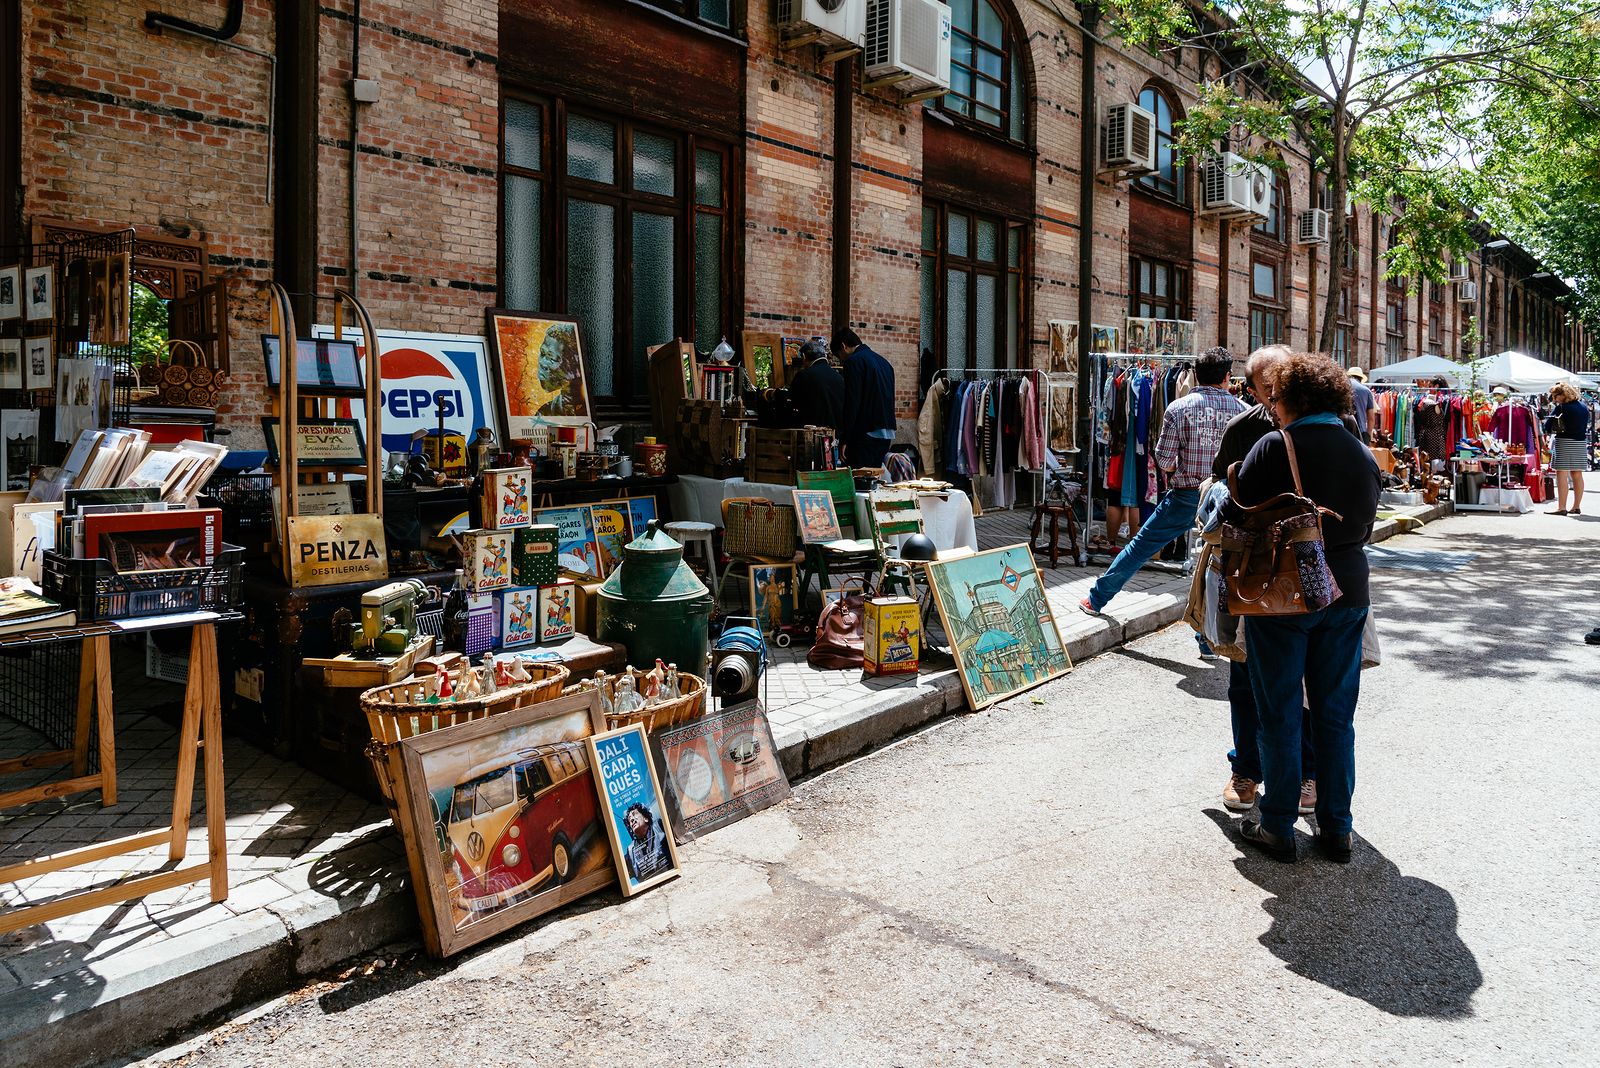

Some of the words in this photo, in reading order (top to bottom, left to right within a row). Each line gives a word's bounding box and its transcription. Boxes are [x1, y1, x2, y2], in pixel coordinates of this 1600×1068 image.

[297, 426, 309, 434] OR
[304, 435, 344, 444] EVA
[500, 516, 515, 525] Cola
[597, 525, 616, 534] AROS
[300, 539, 379, 563] PENZA
[311, 564, 370, 576] DESTILERIAS
[479, 578, 494, 588] Cola
[495, 576, 509, 584] Cao
[505, 634, 519, 643] Cola
[520, 631, 533, 640] Cao
[544, 628, 559, 637] Cola
[560, 625, 573, 634] Cao
[597, 735, 629, 764] DALÍ
[602, 753, 636, 779] CADA
[608, 769, 641, 796] QUÉS
